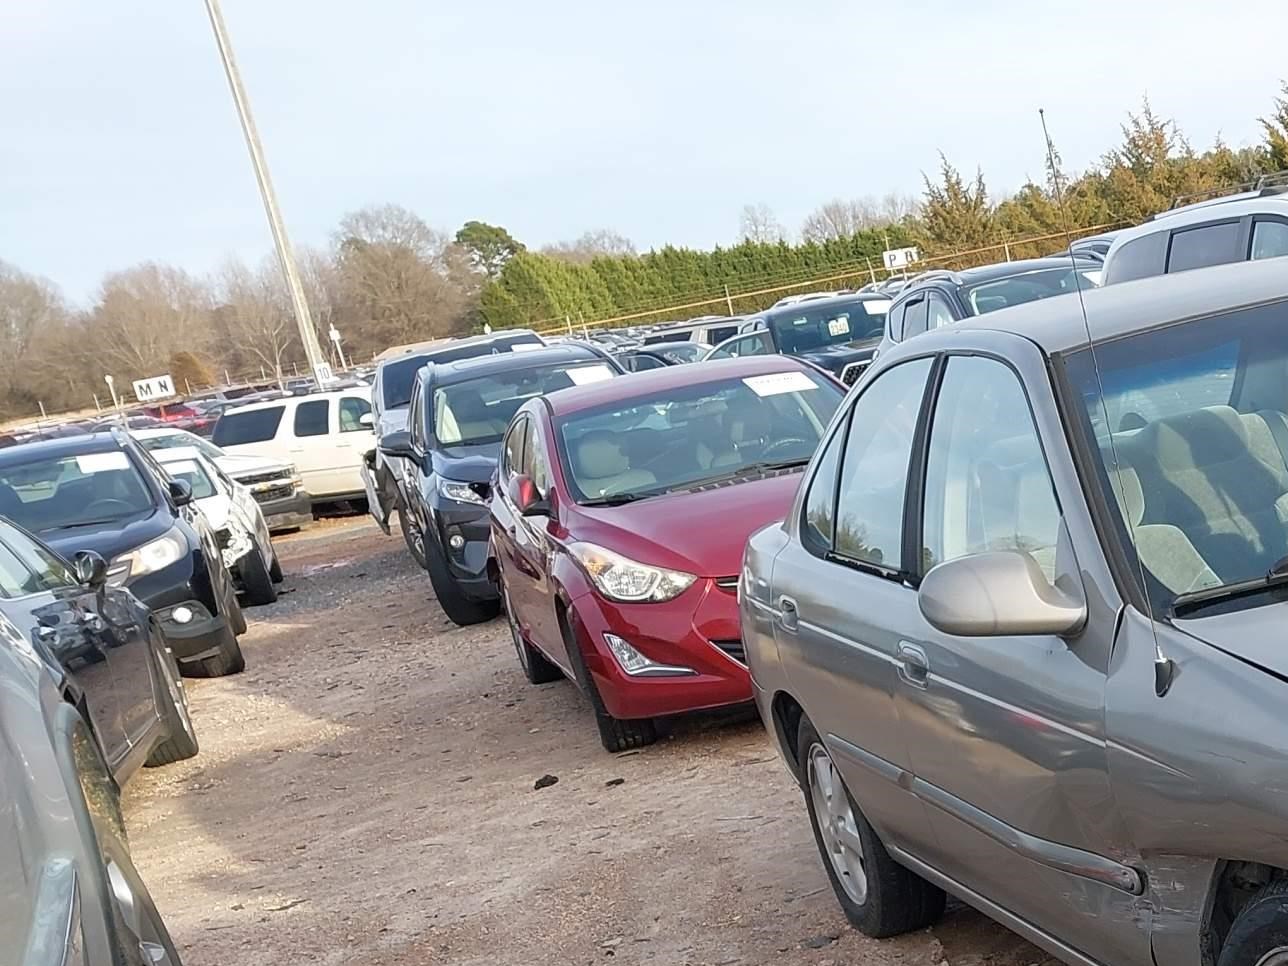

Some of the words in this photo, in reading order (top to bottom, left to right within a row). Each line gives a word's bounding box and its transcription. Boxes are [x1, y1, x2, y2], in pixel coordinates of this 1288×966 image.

[889, 254, 896, 267] P
[319, 367, 330, 379] 10
[138, 383, 152, 397] M
[158, 379, 169, 392] N
